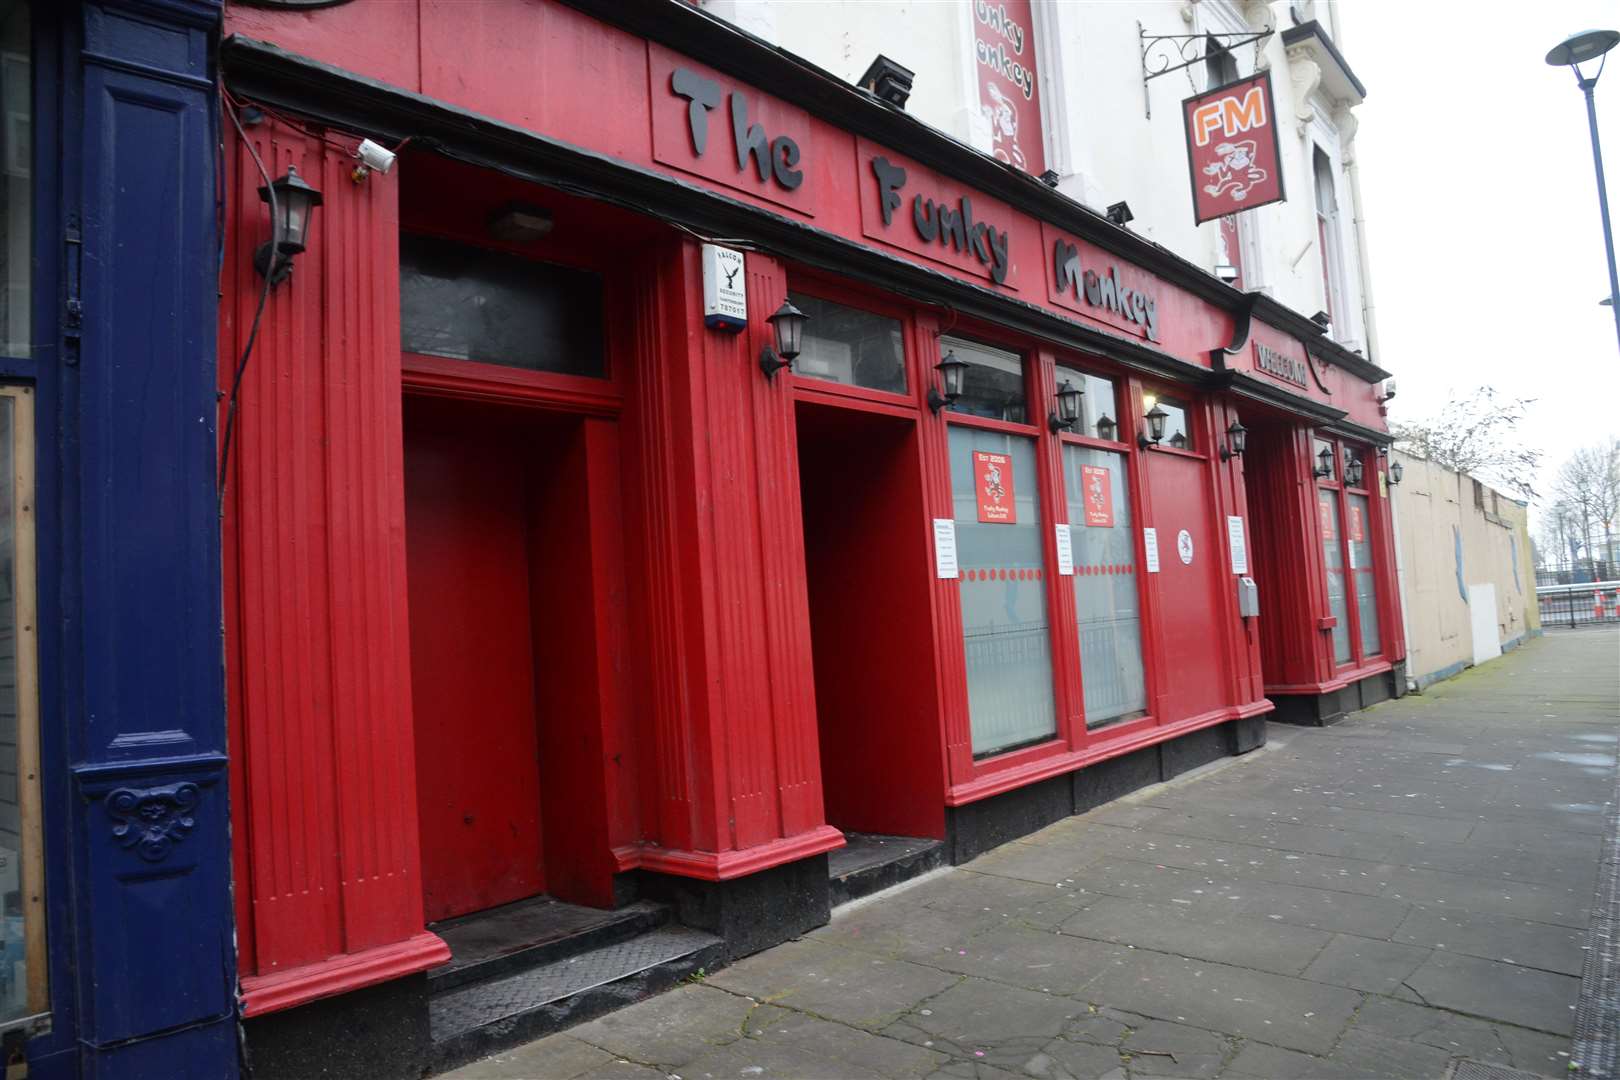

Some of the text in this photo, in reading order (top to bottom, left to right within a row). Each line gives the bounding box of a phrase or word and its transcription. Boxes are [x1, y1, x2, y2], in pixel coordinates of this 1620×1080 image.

[976, 0, 1024, 55] unky
[976, 38, 1032, 100] onkey
[1193, 86, 1267, 147] FM
[671, 66, 1158, 341] The Funky Monkey
